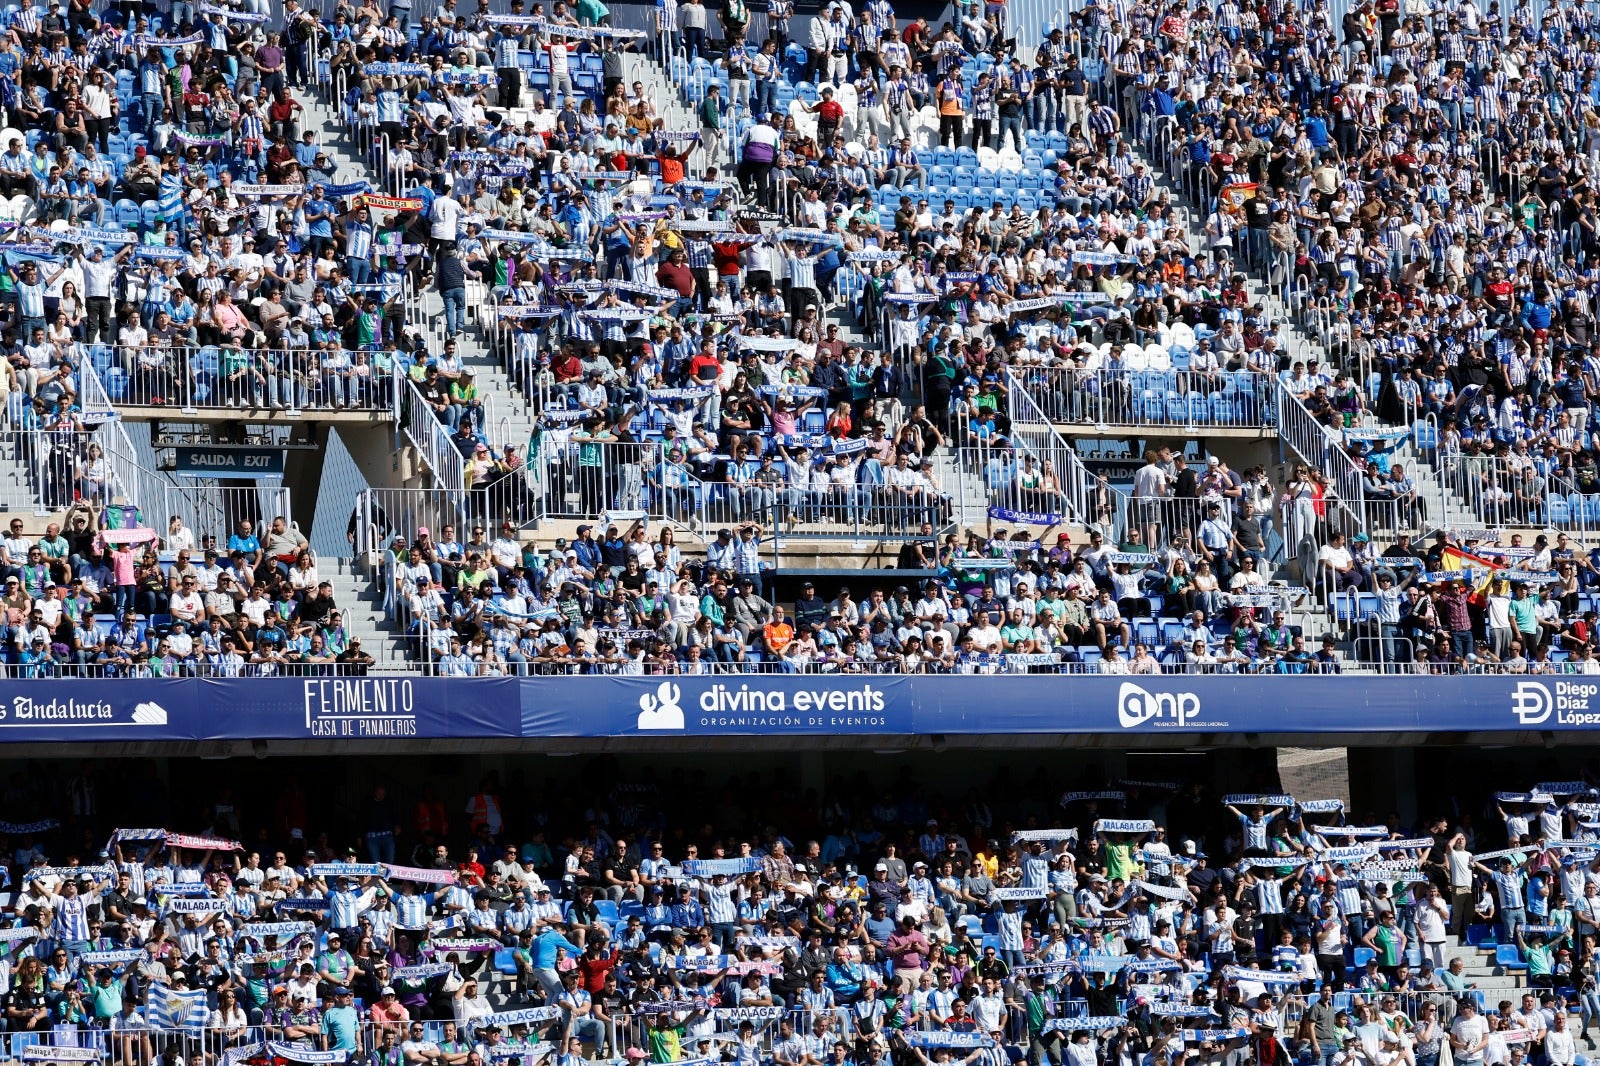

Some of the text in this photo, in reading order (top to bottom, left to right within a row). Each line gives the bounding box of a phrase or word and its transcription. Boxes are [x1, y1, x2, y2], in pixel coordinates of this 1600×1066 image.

[852, 251, 898, 261] MALAGA
[600, 309, 640, 319] MALAGA
[660, 386, 702, 399] MALAGA
[190, 453, 272, 466] SALIDA EXIT
[1010, 654, 1053, 664] MALAGA
[1556, 682, 1598, 698] Diego
[304, 679, 413, 728] FERMENTO
[700, 684, 885, 711] divina events
[1557, 695, 1589, 710] Díaz
[13, 696, 113, 719] Andalucía
[1123, 691, 1201, 727] anp
[700, 715, 886, 726] ORGANIZACIÓN DE EVENTOS
[1558, 709, 1600, 726] López
[311, 719, 416, 736] CASA DE PANADEROS
[1300, 800, 1340, 810] MALAG
[1103, 821, 1134, 831] MALAGA
[183, 835, 226, 848] MALAGA
[174, 901, 227, 911] MALAGA C.F.
[250, 923, 301, 935] MALAGA
[484, 1009, 544, 1025] MALAGA
[731, 1008, 775, 1018] MALAGA
[928, 1033, 974, 1046] MALAGA
